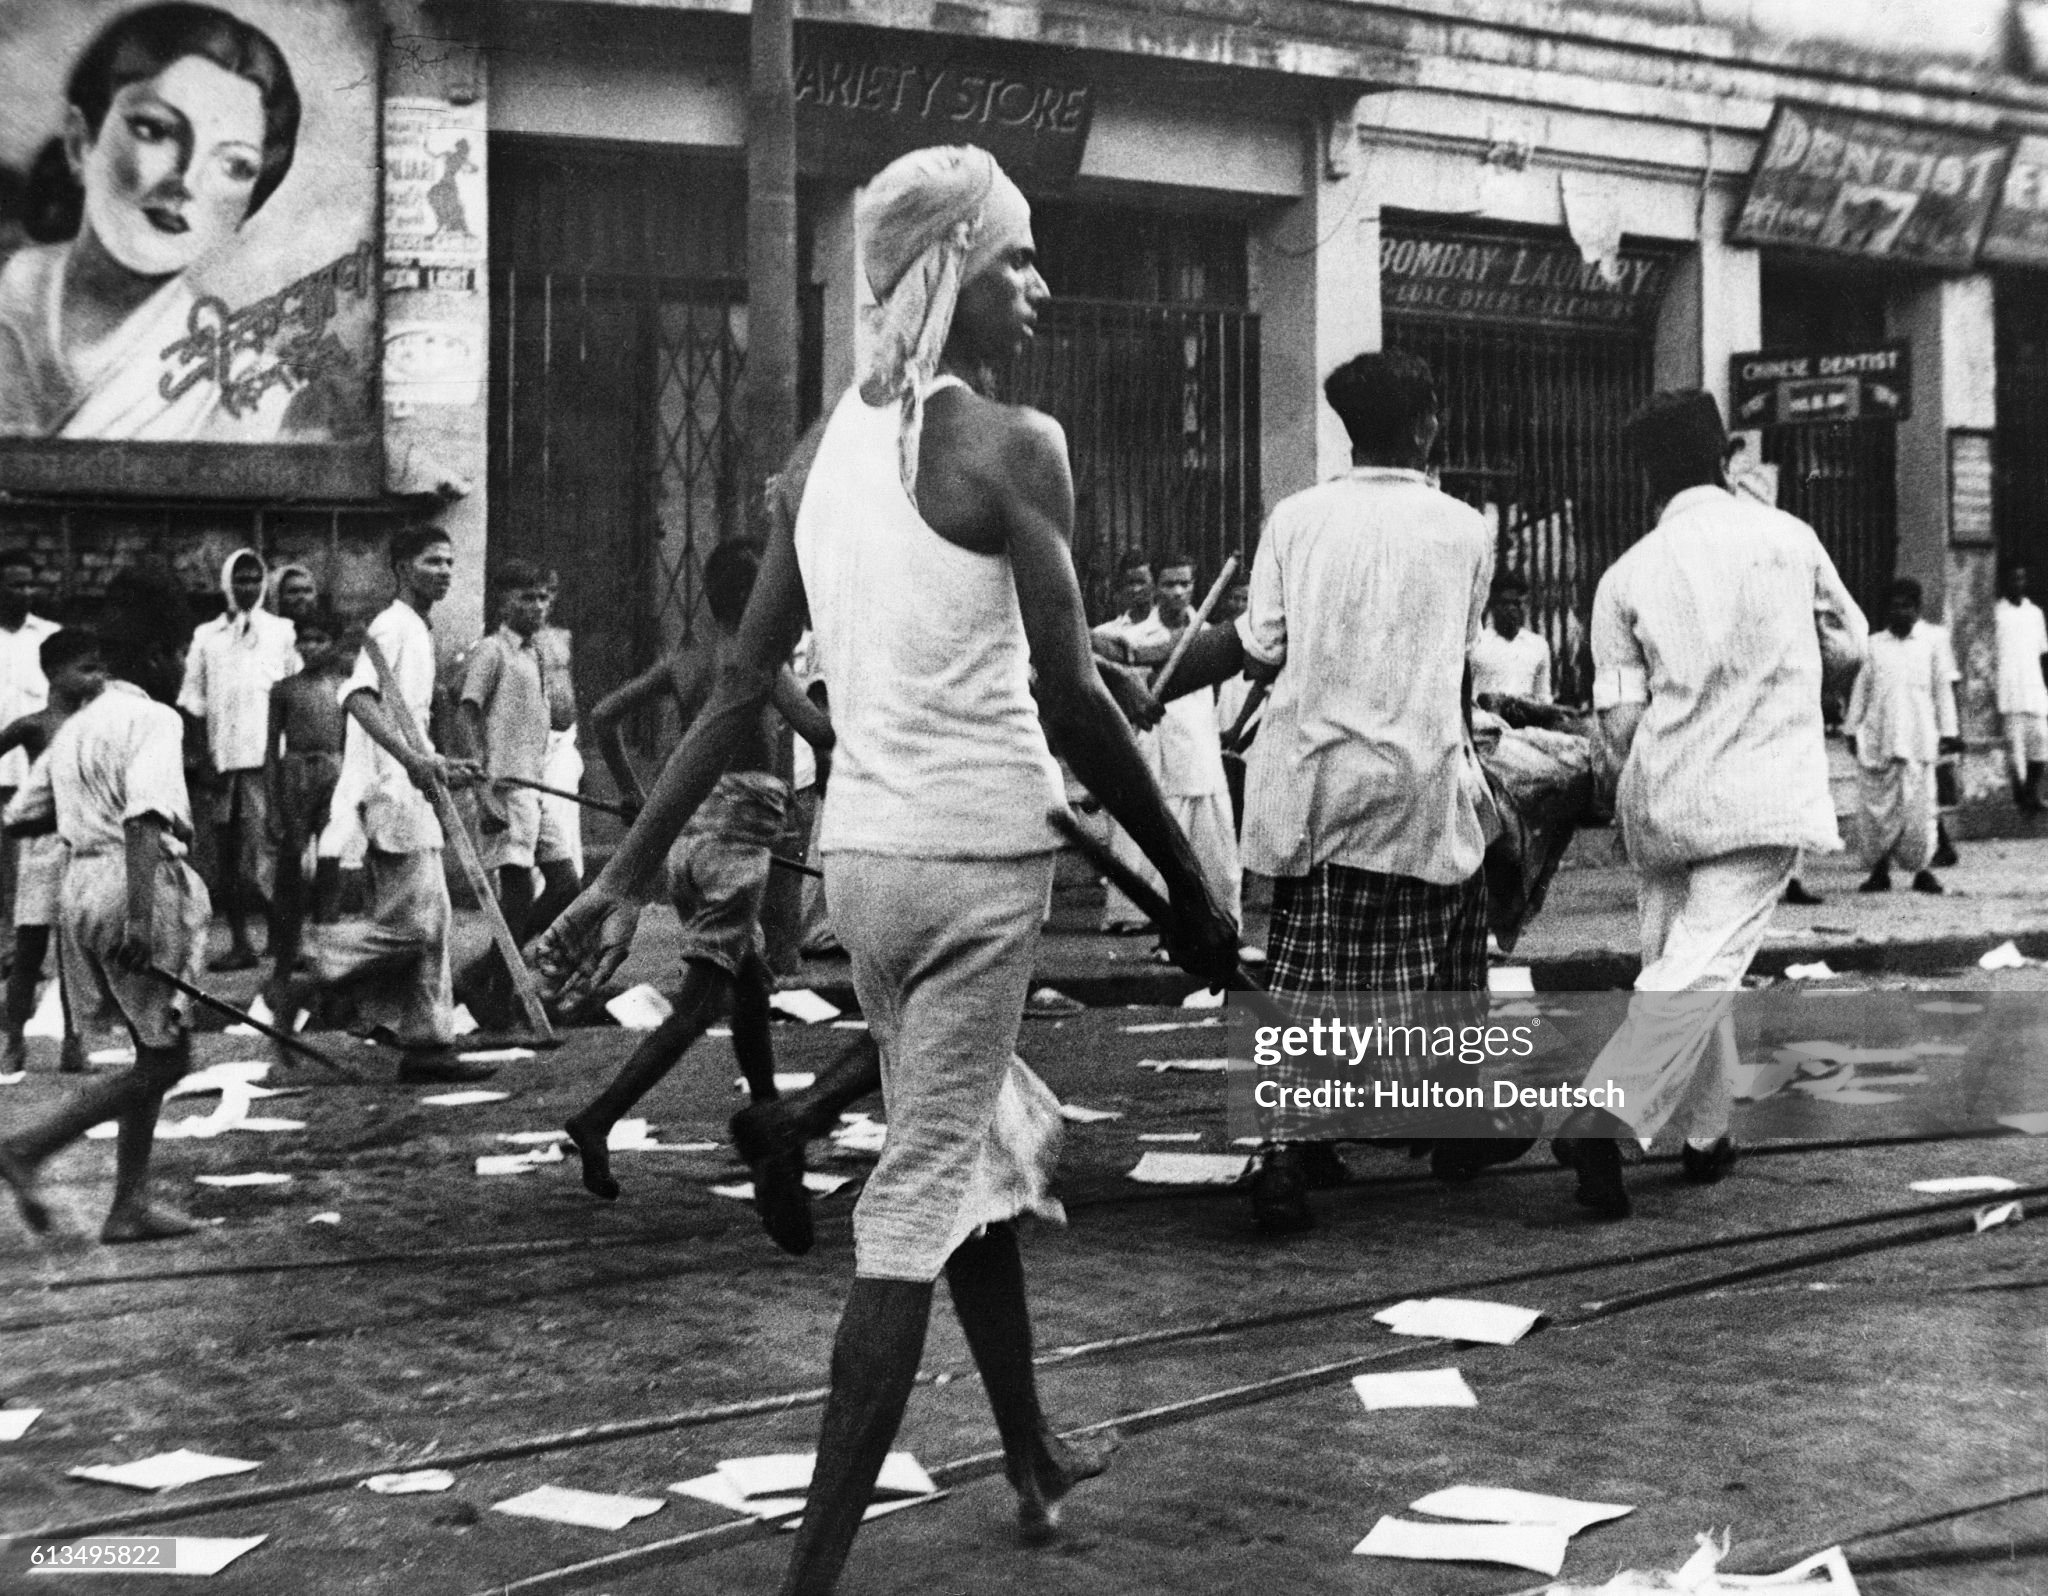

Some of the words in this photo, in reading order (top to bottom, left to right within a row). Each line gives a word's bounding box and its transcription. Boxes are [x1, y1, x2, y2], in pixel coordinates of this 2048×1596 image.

[797, 54, 944, 118] ARIETY
[951, 76, 1087, 134] STORE
[1762, 105, 2009, 200] DENTIST
[1381, 237, 1500, 283] BOMBAY
[1819, 351, 1898, 375] DENTIST
